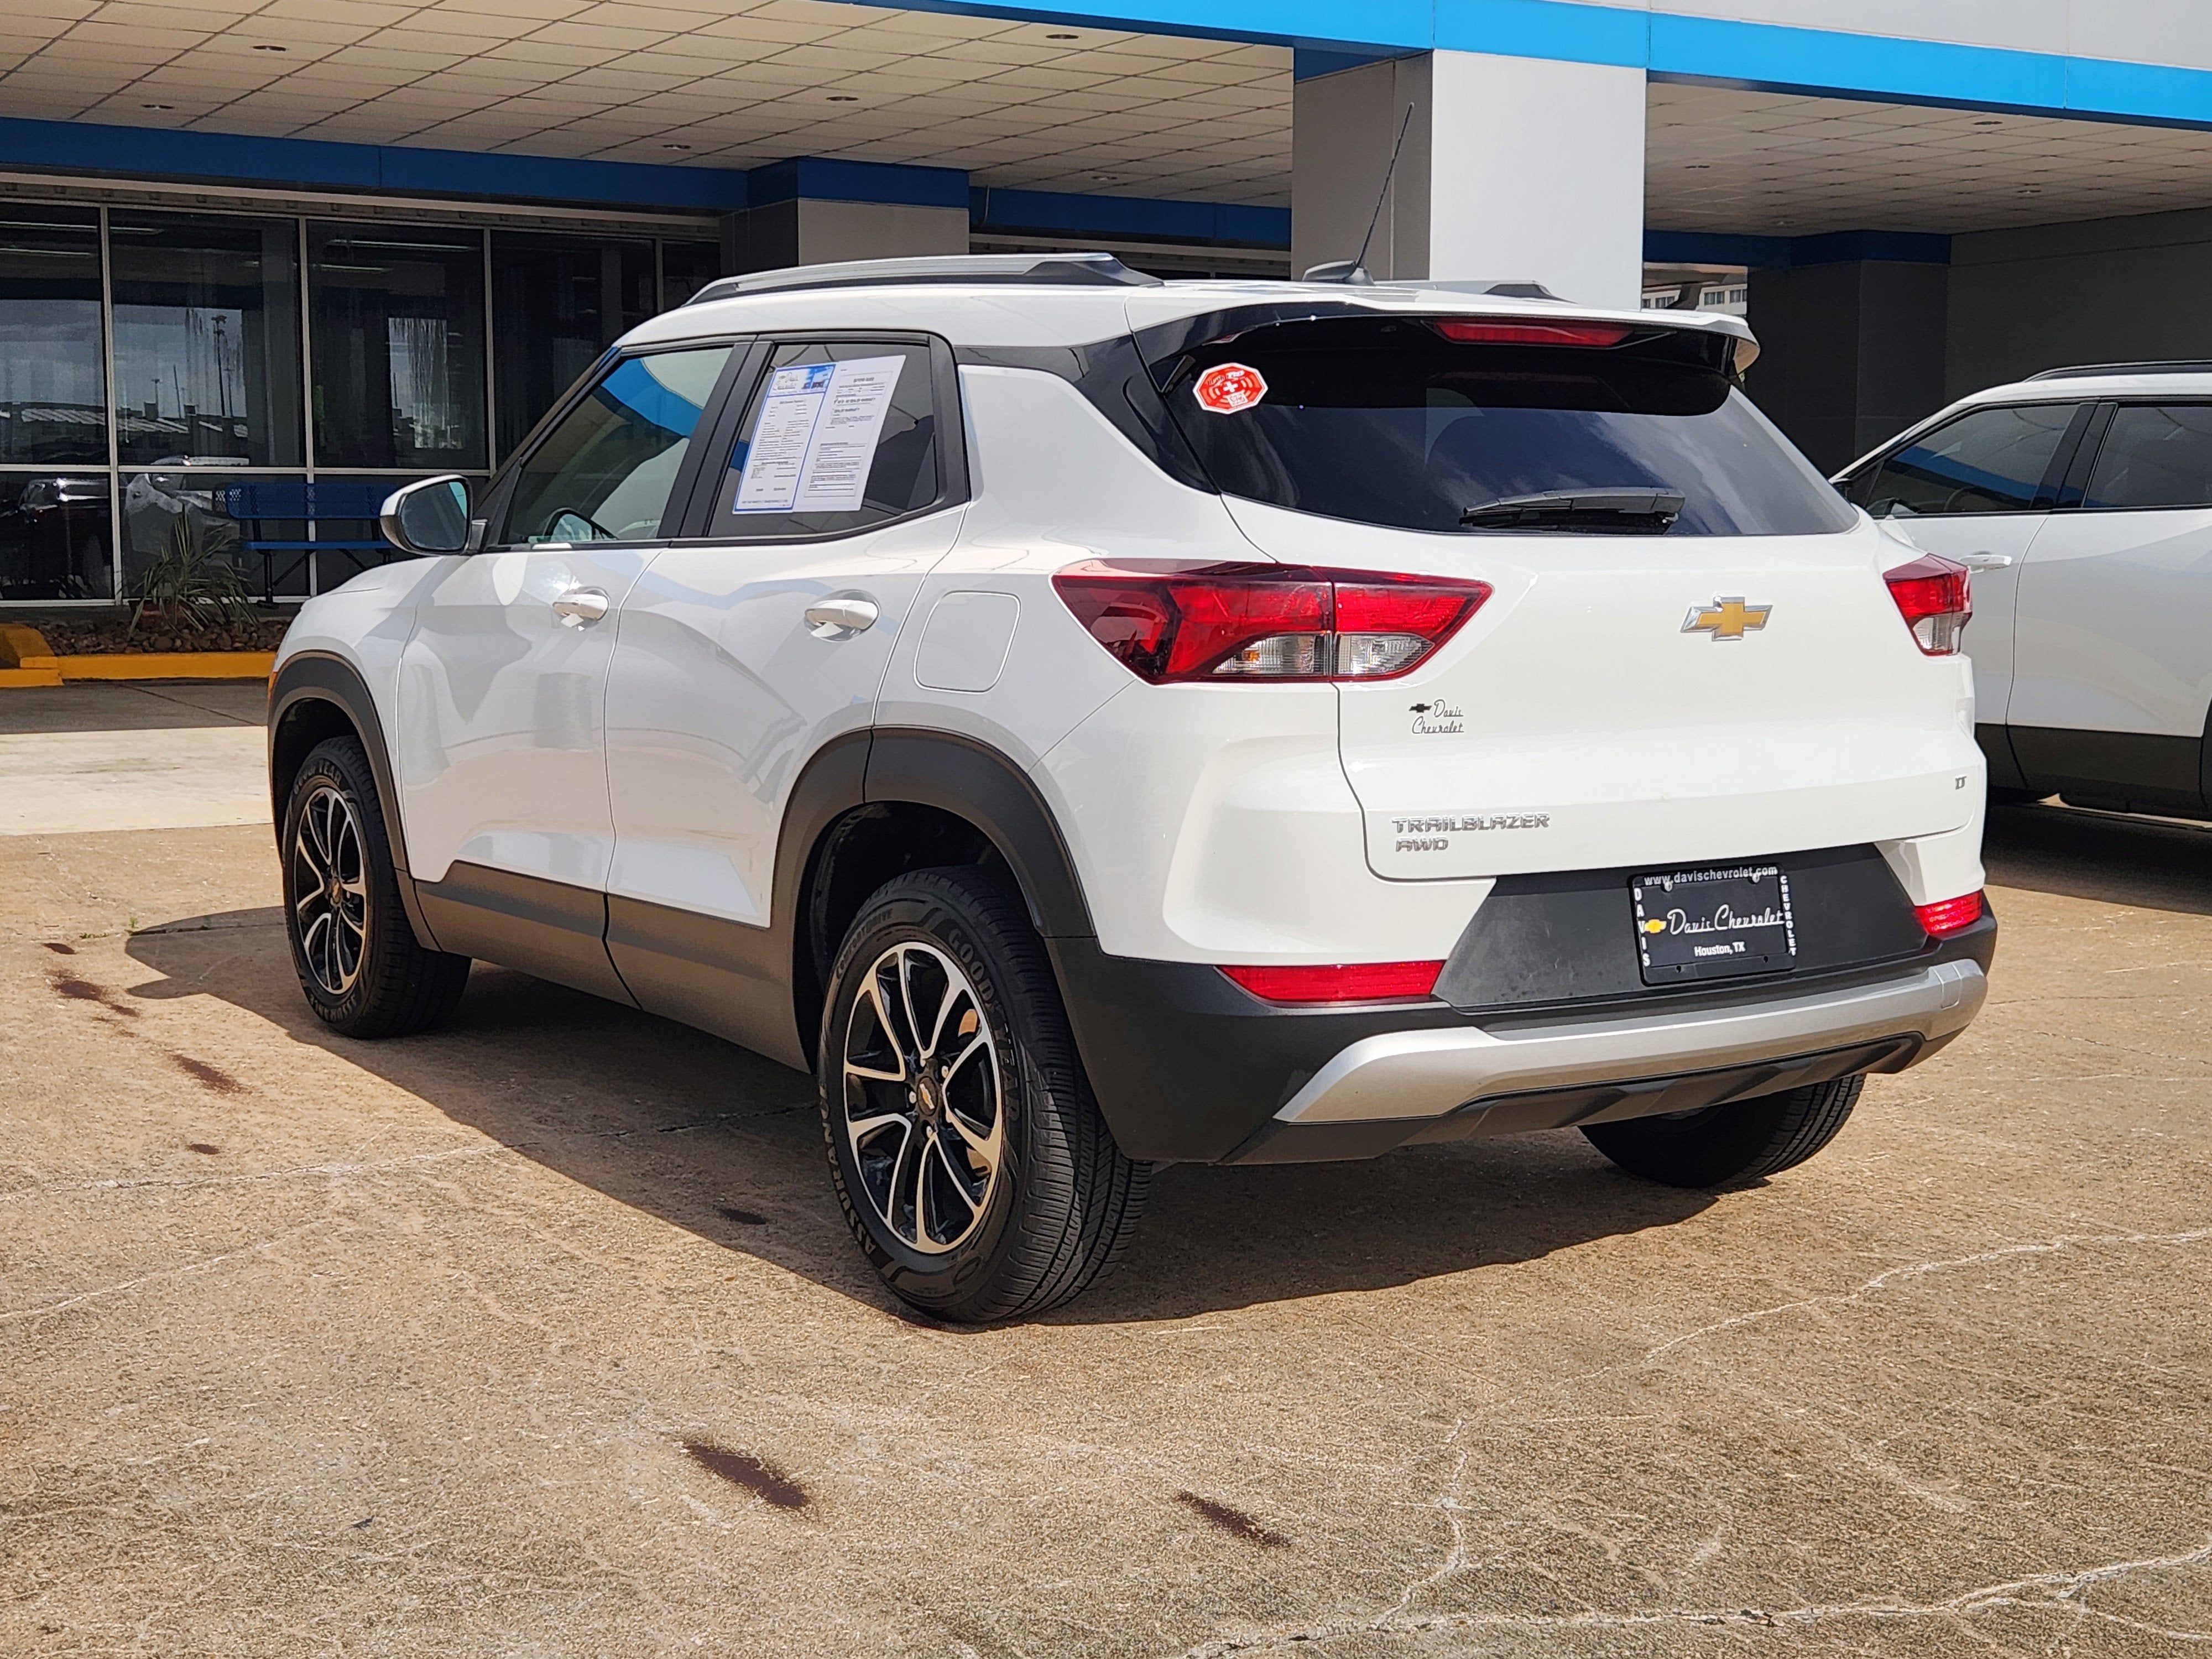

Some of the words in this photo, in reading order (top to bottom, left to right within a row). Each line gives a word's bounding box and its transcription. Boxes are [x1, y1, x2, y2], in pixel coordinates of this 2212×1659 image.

[1433, 698, 1464, 717] Davis
[1412, 716, 1464, 734] Chevrolet
[1392, 812, 1550, 833] TRAILBLAZER
[1395, 836, 1449, 852] AWD
[1644, 866, 1778, 886] www.davischevrolet.com
[1666, 907, 1715, 936] Davis
[1714, 904, 1786, 931] Chevrolet
[1780, 875, 1797, 957] CHEVROLET
[1634, 887, 1651, 967] DAVIS
[1694, 943, 1733, 957] Houston,
[1732, 941, 1746, 952] TX
